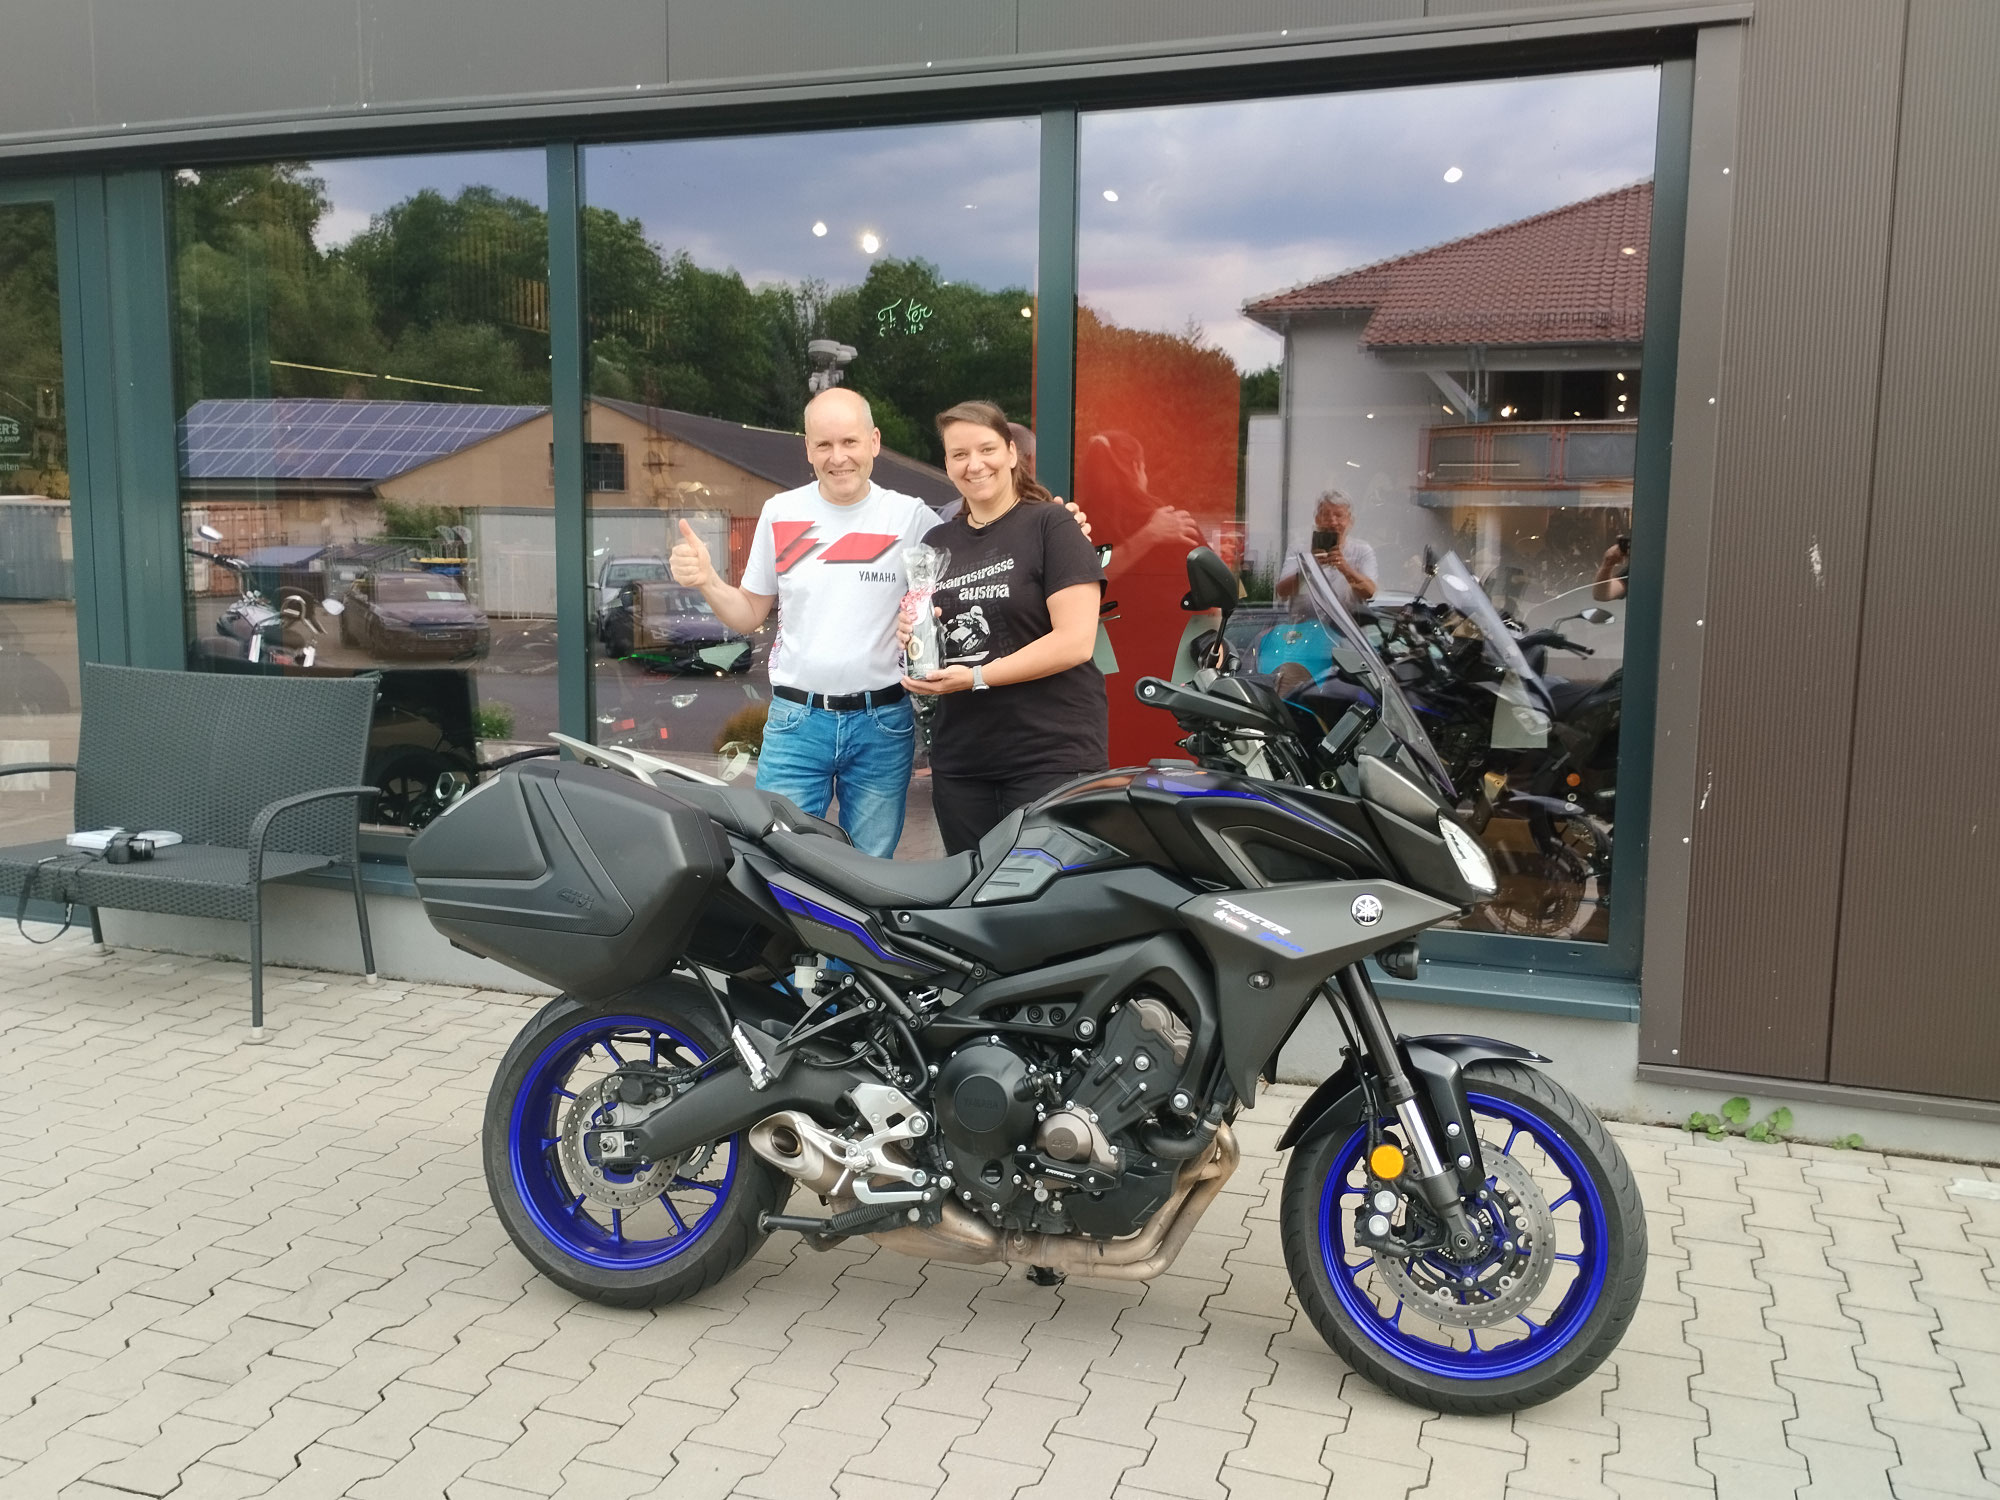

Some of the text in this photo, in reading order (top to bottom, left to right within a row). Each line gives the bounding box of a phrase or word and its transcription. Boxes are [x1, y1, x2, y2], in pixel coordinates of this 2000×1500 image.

[858, 570, 897, 583] YAMAHA
[958, 583, 1010, 601] austria
[1216, 898, 1291, 936] TRACER
